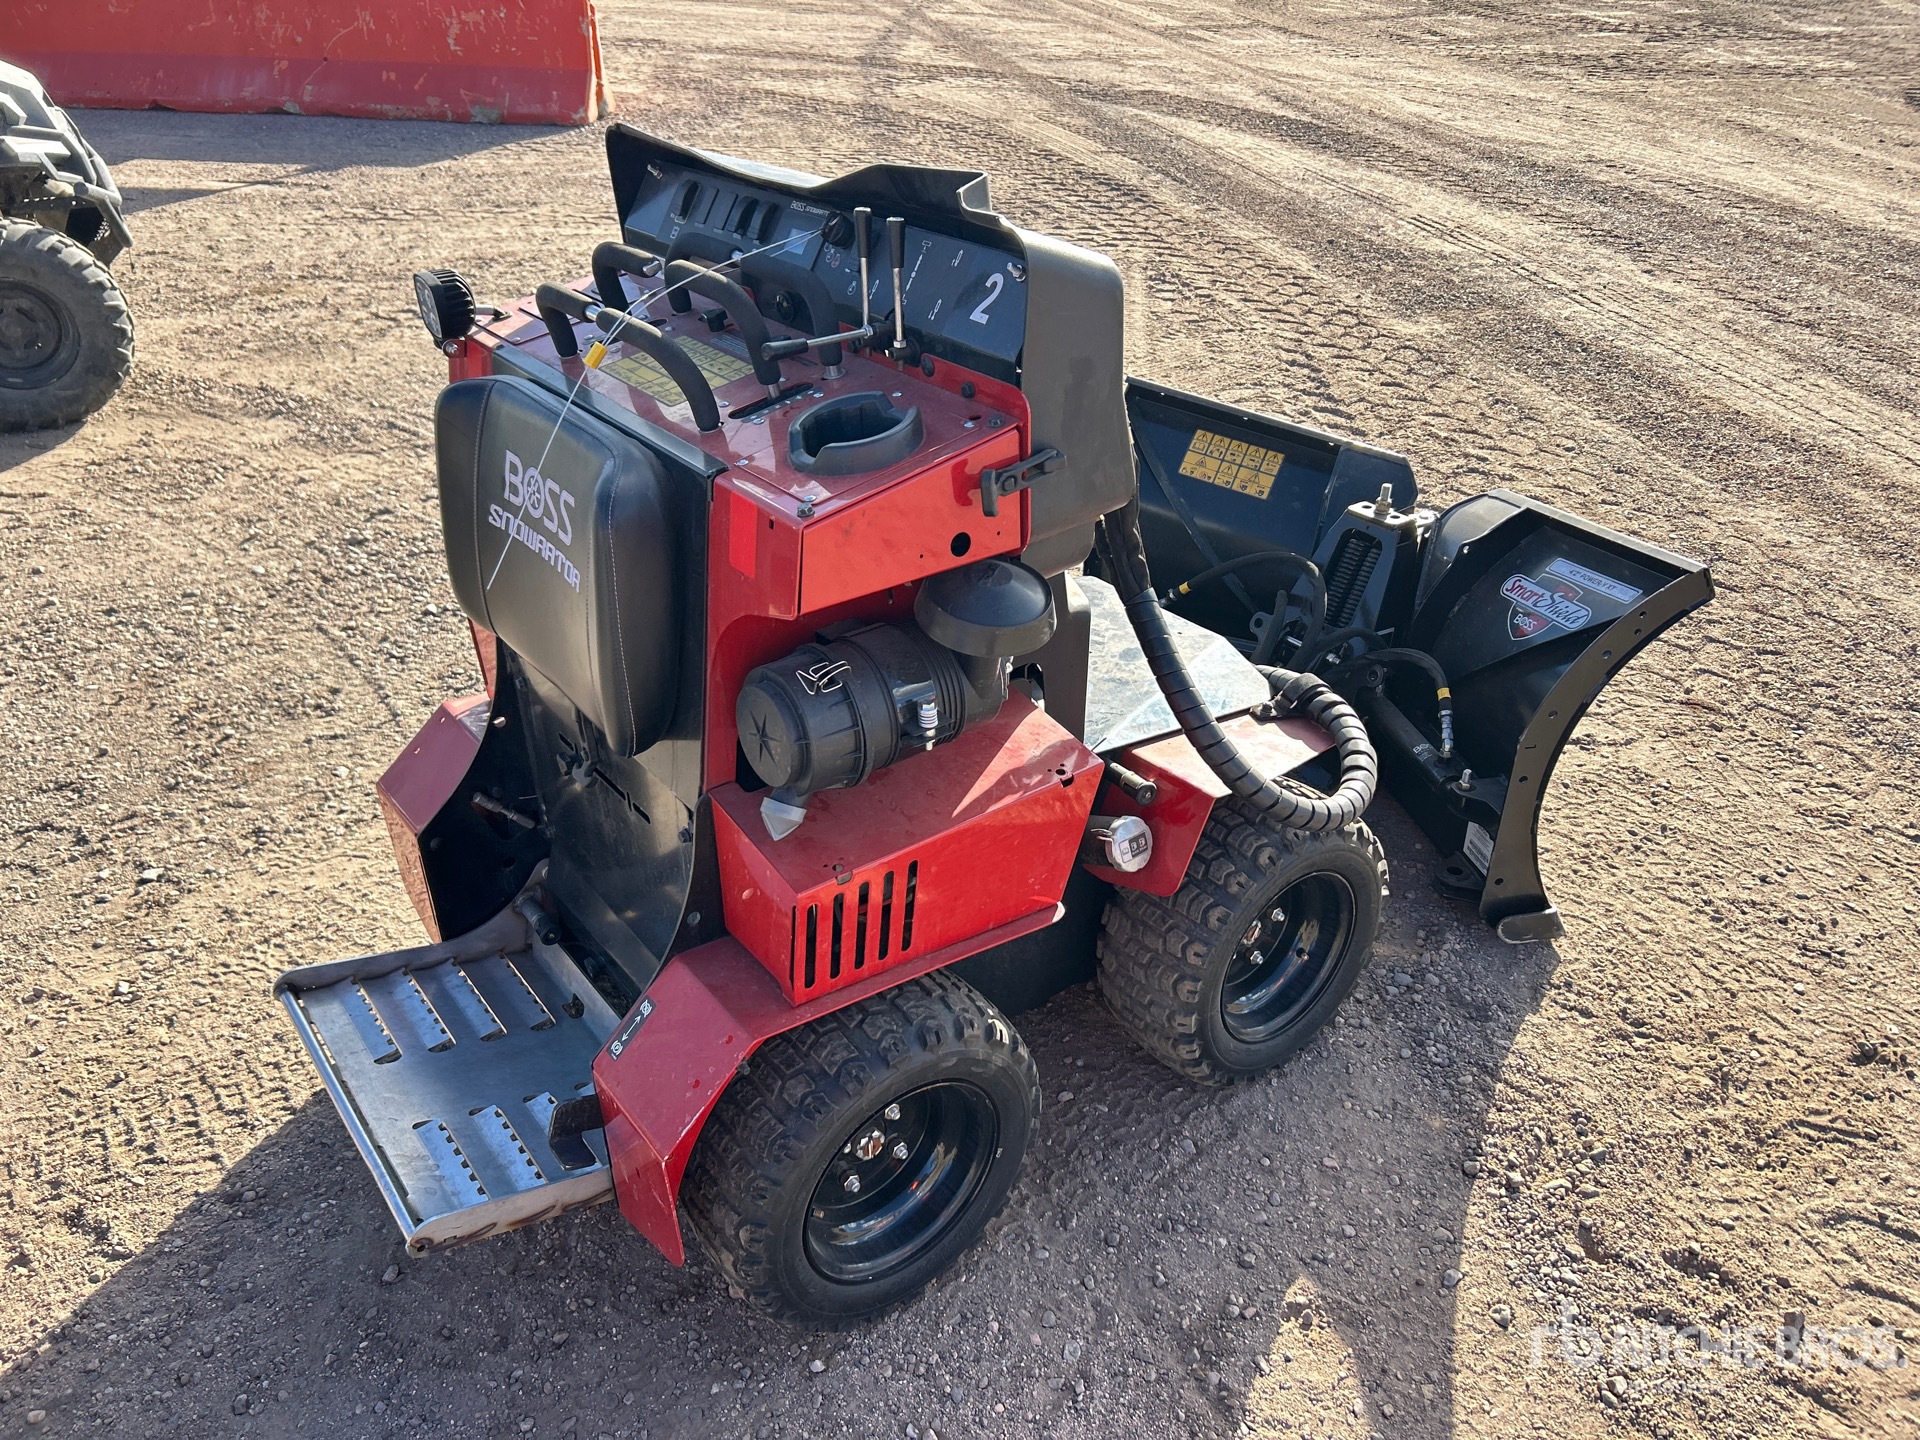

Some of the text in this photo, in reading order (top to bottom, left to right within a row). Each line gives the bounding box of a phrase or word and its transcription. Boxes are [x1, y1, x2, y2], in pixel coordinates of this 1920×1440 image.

[790, 200, 806, 212] BOSS
[969, 273, 1004, 325] 2
[503, 450, 575, 546] BOSS
[488, 503, 581, 593] SNOWRATOR
[1513, 613, 1538, 631] BOSS
